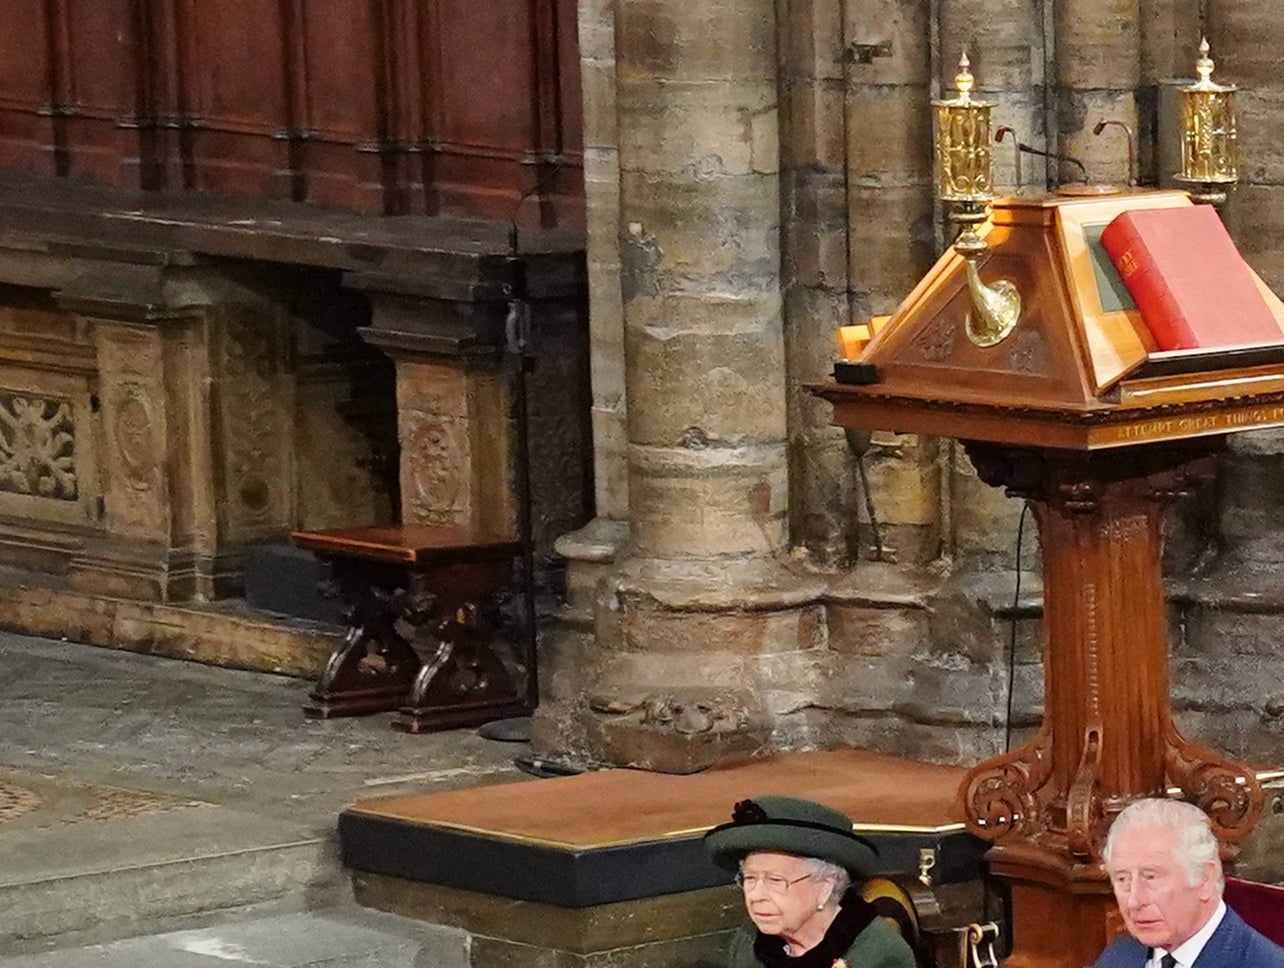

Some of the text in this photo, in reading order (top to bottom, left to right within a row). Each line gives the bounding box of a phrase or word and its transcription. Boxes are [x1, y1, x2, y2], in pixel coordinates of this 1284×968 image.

[1117, 420, 1173, 439] ATTEMPT
[1179, 416, 1216, 431] GREAT
[1225, 410, 1267, 425] THINGS
